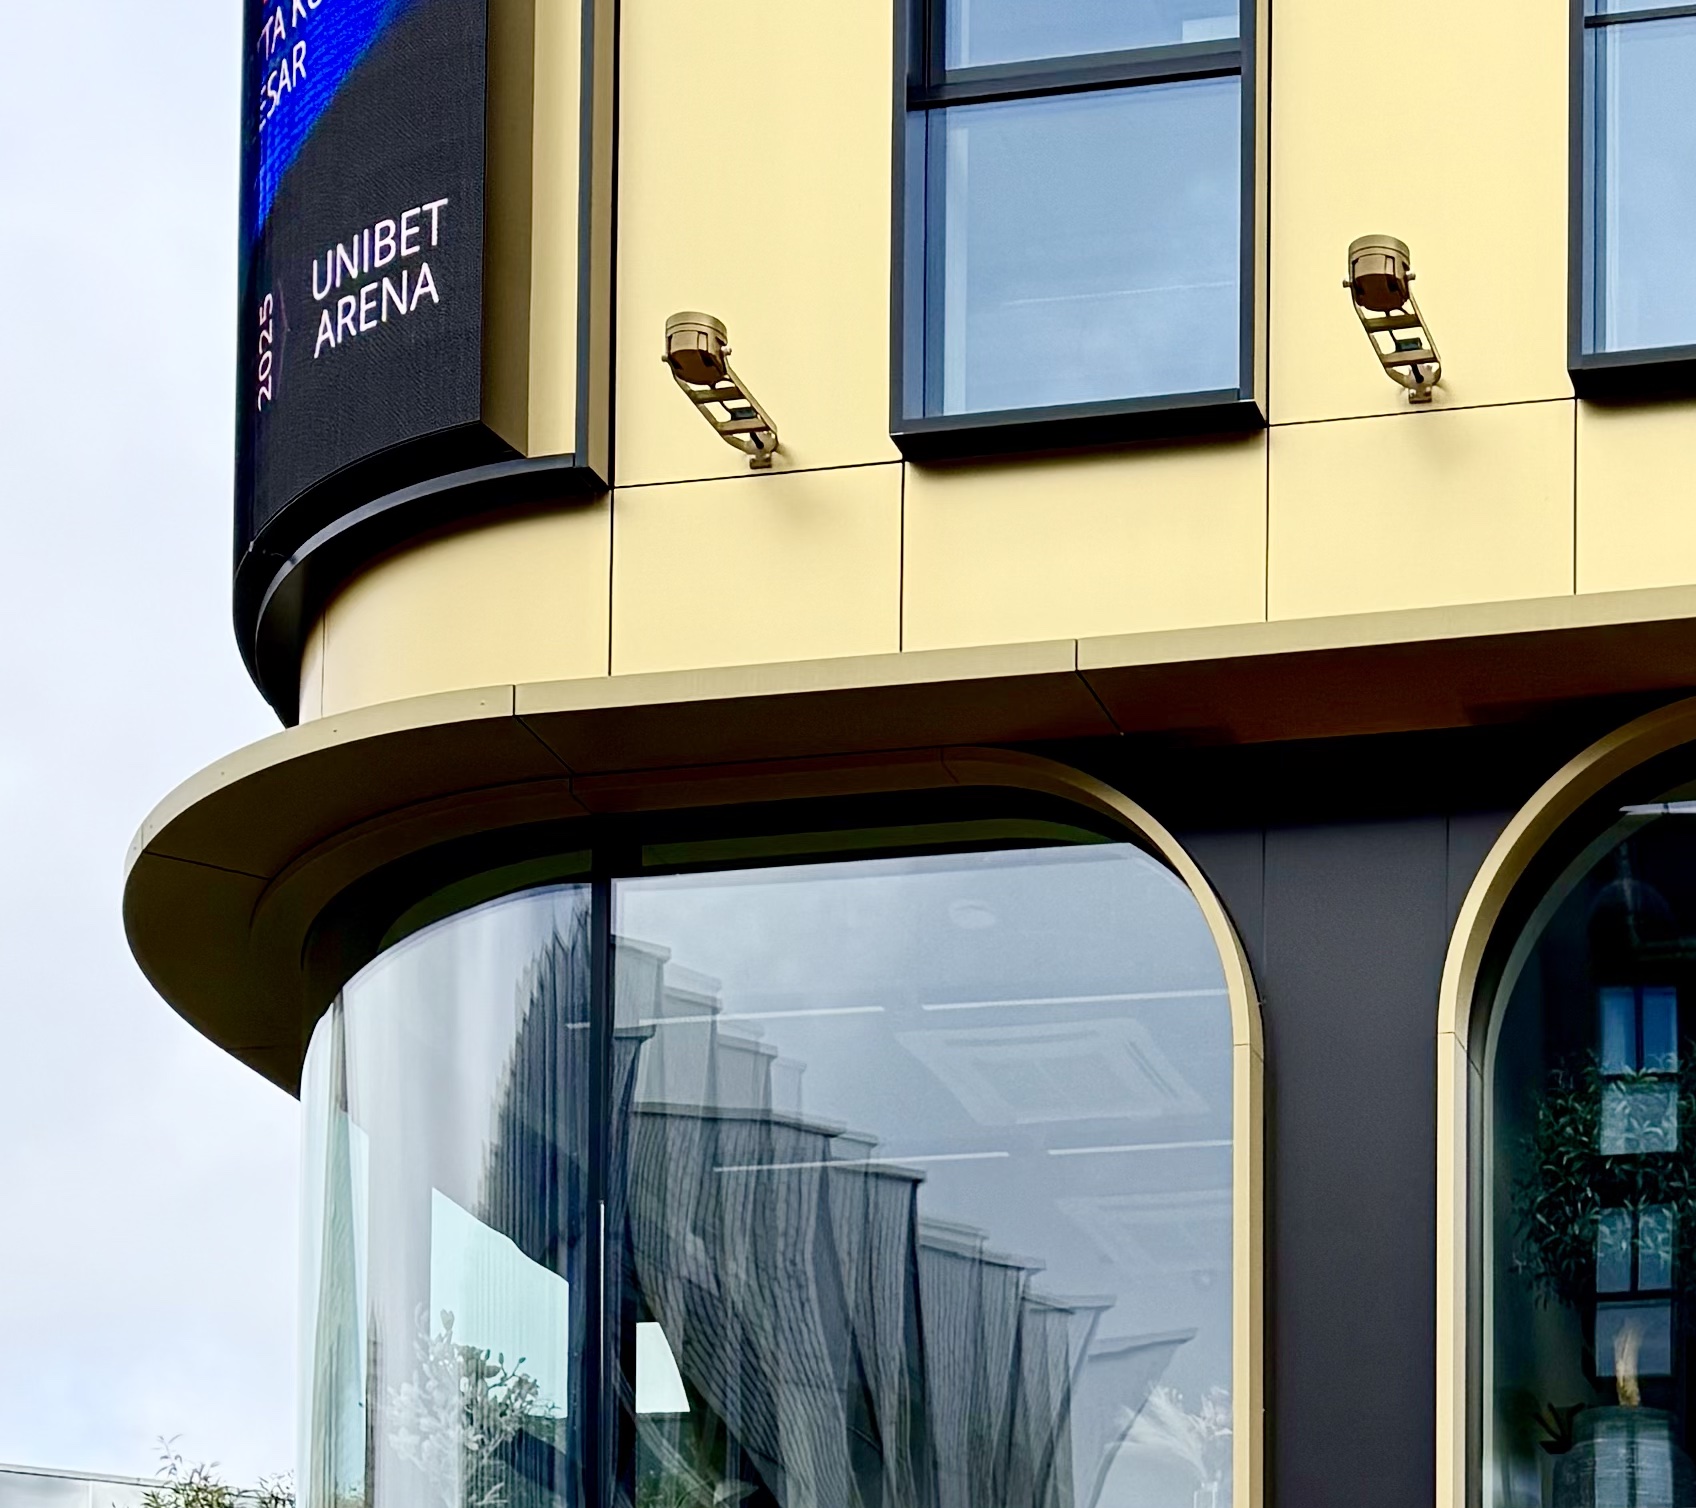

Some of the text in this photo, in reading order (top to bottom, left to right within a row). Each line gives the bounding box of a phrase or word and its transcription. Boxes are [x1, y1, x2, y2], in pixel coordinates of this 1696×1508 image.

[312, 197, 449, 301] UNIBET
[257, 292, 274, 412] 2025
[313, 262, 440, 359] ARENA
